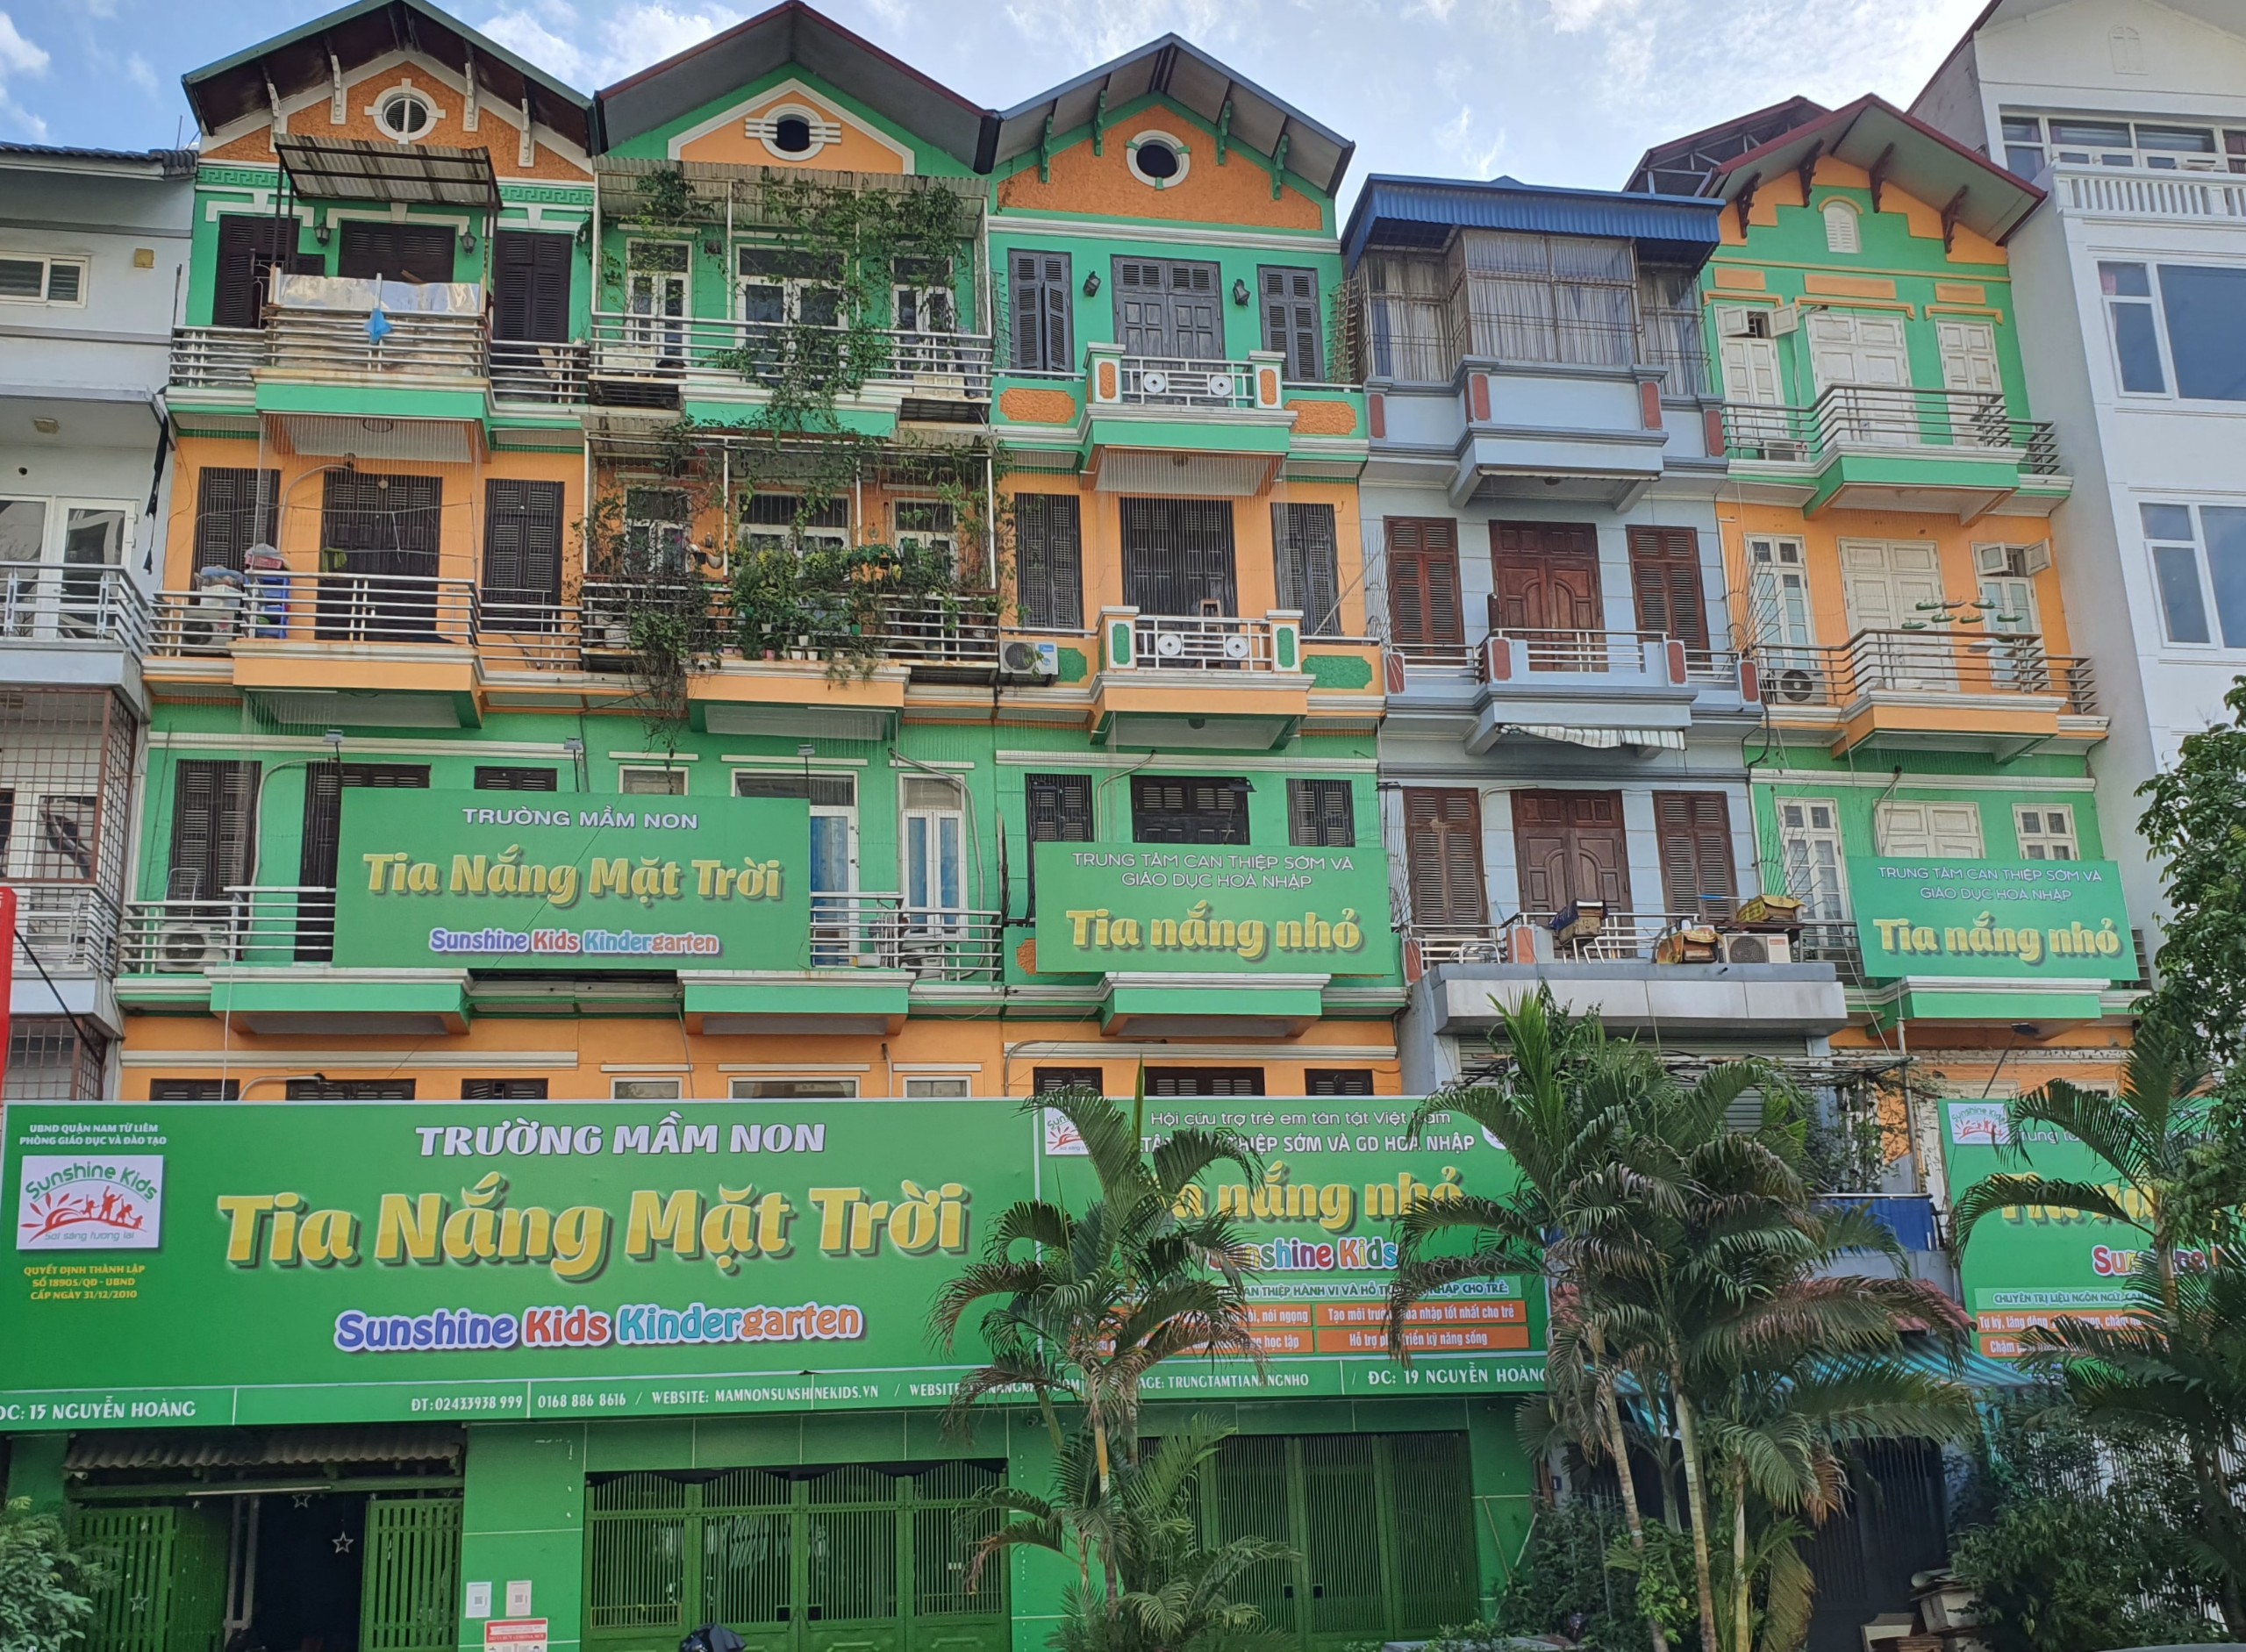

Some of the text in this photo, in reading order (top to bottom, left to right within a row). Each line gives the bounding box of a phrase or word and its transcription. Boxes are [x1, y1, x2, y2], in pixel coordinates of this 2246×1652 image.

[462, 805, 698, 830] TRƯỜNG MẦM NON
[1071, 851, 1355, 872] TRUNG TÂM CAN THIỆP SỚM VÀ
[362, 844, 783, 906] Tia Nắng Mặt Trời
[1121, 870, 1313, 891] GIÁO DỤC HOÀ NHẬP
[1877, 866, 2102, 883] TRUNG TÂM CAN THIỆP SỚM VÀ
[1920, 886, 1957, 899] GIÁO
[1960, 888, 1992, 902] DỤC
[2032, 888, 2071, 903] NHẬP
[1066, 899, 1362, 959] Tia nắng nhỏ
[1872, 911, 2121, 963] Tia nắng nhỏ
[429, 927, 721, 955] Sunshine Kids Kindergarten
[30, 1122, 159, 1135] UBND QUẬN NAM TỪ LIÊM
[1151, 1112, 1179, 1127] Hội
[1184, 1112, 1216, 1126] cứu
[1221, 1112, 1246, 1127] trợ
[1250, 1111, 1275, 1126] trẻ
[1279, 1116, 1306, 1126] em
[1312, 1112, 1340, 1125] tàn
[1345, 1112, 1369, 1126] tật
[1373, 1111, 1407, 1126] Việt
[19, 1134, 167, 1147] PHÒNG GIÁO DỤC VÀ ĐÀO TẠO
[415, 1111, 826, 1157] TRƯỜNG MẦM NON
[1284, 1132, 1322, 1152] SỚM
[1327, 1132, 1351, 1152] VÀ
[1355, 1135, 1380, 1152] GD
[1426, 1131, 1476, 1155] NHẬP
[25, 1162, 158, 1200] Sunshine Kids
[1217, 1160, 1352, 1230] nắng
[217, 1170, 967, 1277] Tia Nắng Mặt Trời
[1338, 1236, 1398, 1270] Kids
[24, 1263, 146, 1277] QUYẾT ĐỊNH THÀNH LẬP
[32, 1277, 46, 1287] SỐ
[105, 1277, 135, 1286] UBND
[1243, 1280, 1377, 1298] AN THIỆP HÀNH VI VÀ HỖ
[1463, 1284, 1484, 1295] CHO
[31, 1289, 137, 1300] CẤP NGÀY 31/12/2010
[1994, 1291, 2032, 1304] CHUYÊN
[2034, 1292, 2048, 1305] TRỊ
[2071, 1291, 2099, 1303] NGÔN
[1262, 1308, 1308, 1325] nói ngọng
[1328, 1304, 1514, 1323] Tạo môi nhập tốt nhất cho trẻ
[334, 1301, 864, 1352] Sunshine Kids Kindergarten
[1440, 1330, 1463, 1345] năng
[1465, 1328, 1488, 1346] sống
[1264, 1338, 1282, 1352] học
[1284, 1335, 1299, 1350] tập
[1349, 1331, 1362, 1347] Hỗ
[1364, 1334, 1377, 1349] trợ
[1169, 1373, 1309, 1389] TRUNGTAMTIANNGNHO
[1368, 1370, 1397, 1385] ĐC:
[1404, 1370, 1420, 1384] 19
[1426, 1362, 1489, 1384] NGUYỄN
[499, 1394, 523, 1409] 999
[537, 1394, 567, 1408] 0168
[571, 1393, 594, 1406] 886
[599, 1392, 626, 1406] 8616
[652, 1390, 710, 1405] WEBSITE:
[909, 1383, 962, 1397] WEBSITE
[29, 1405, 46, 1420] 15
[52, 1395, 125, 1420] NGUYỄN
[131, 1398, 196, 1418] HOÀNG
